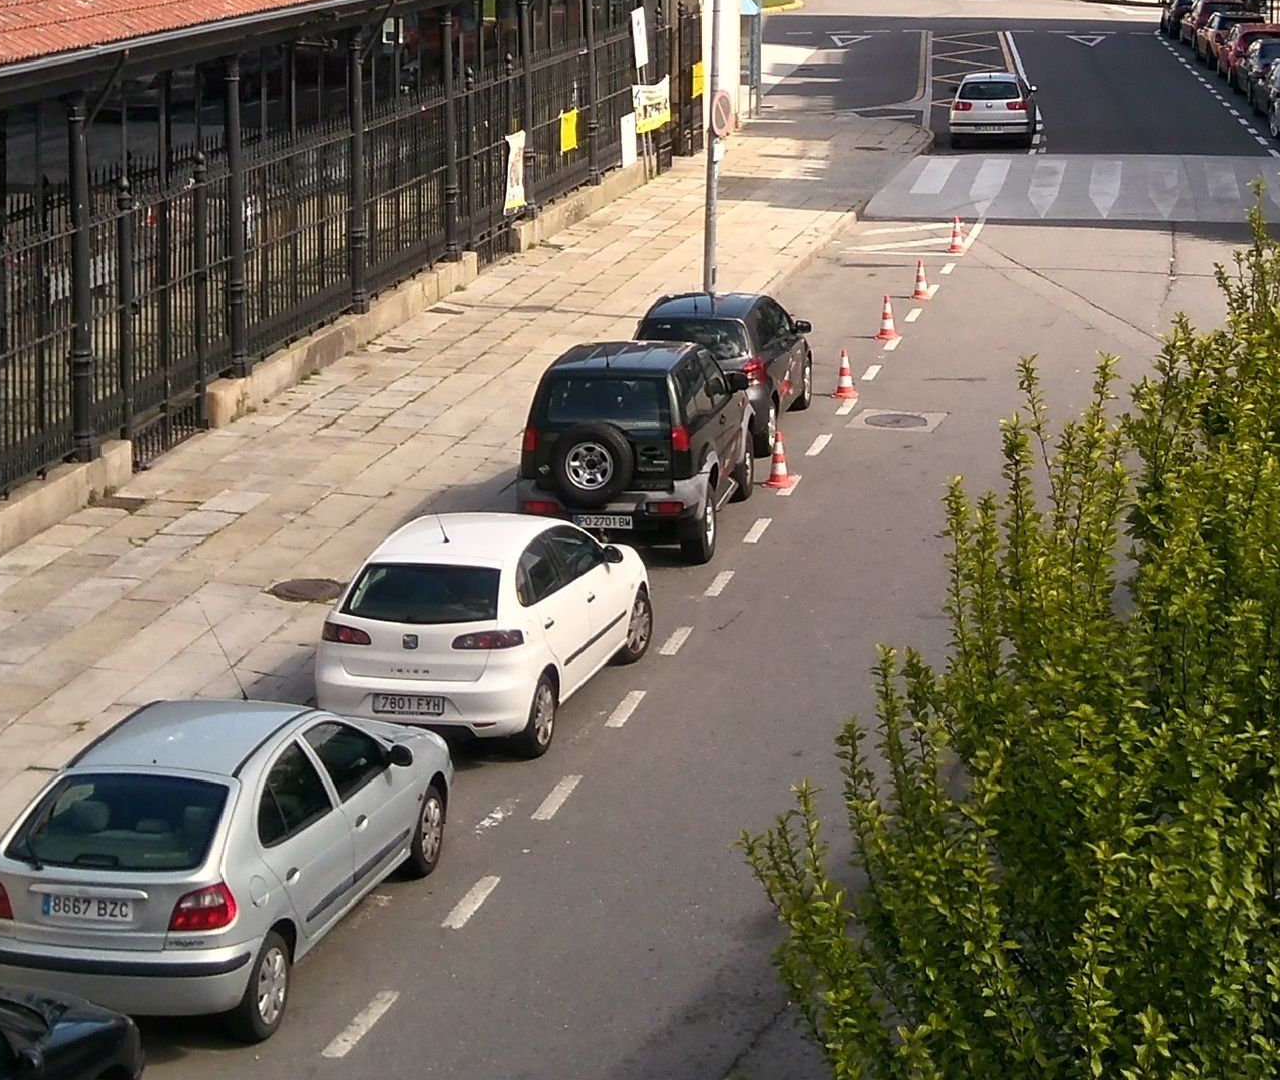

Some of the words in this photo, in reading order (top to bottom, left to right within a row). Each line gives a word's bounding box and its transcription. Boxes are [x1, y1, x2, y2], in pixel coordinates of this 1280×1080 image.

[593, 516, 616, 527] 2701
[381, 696, 411, 710] 7801
[417, 698, 440, 711] FYH
[52, 896, 91, 915] 8667
[97, 901, 129, 918] BZC
